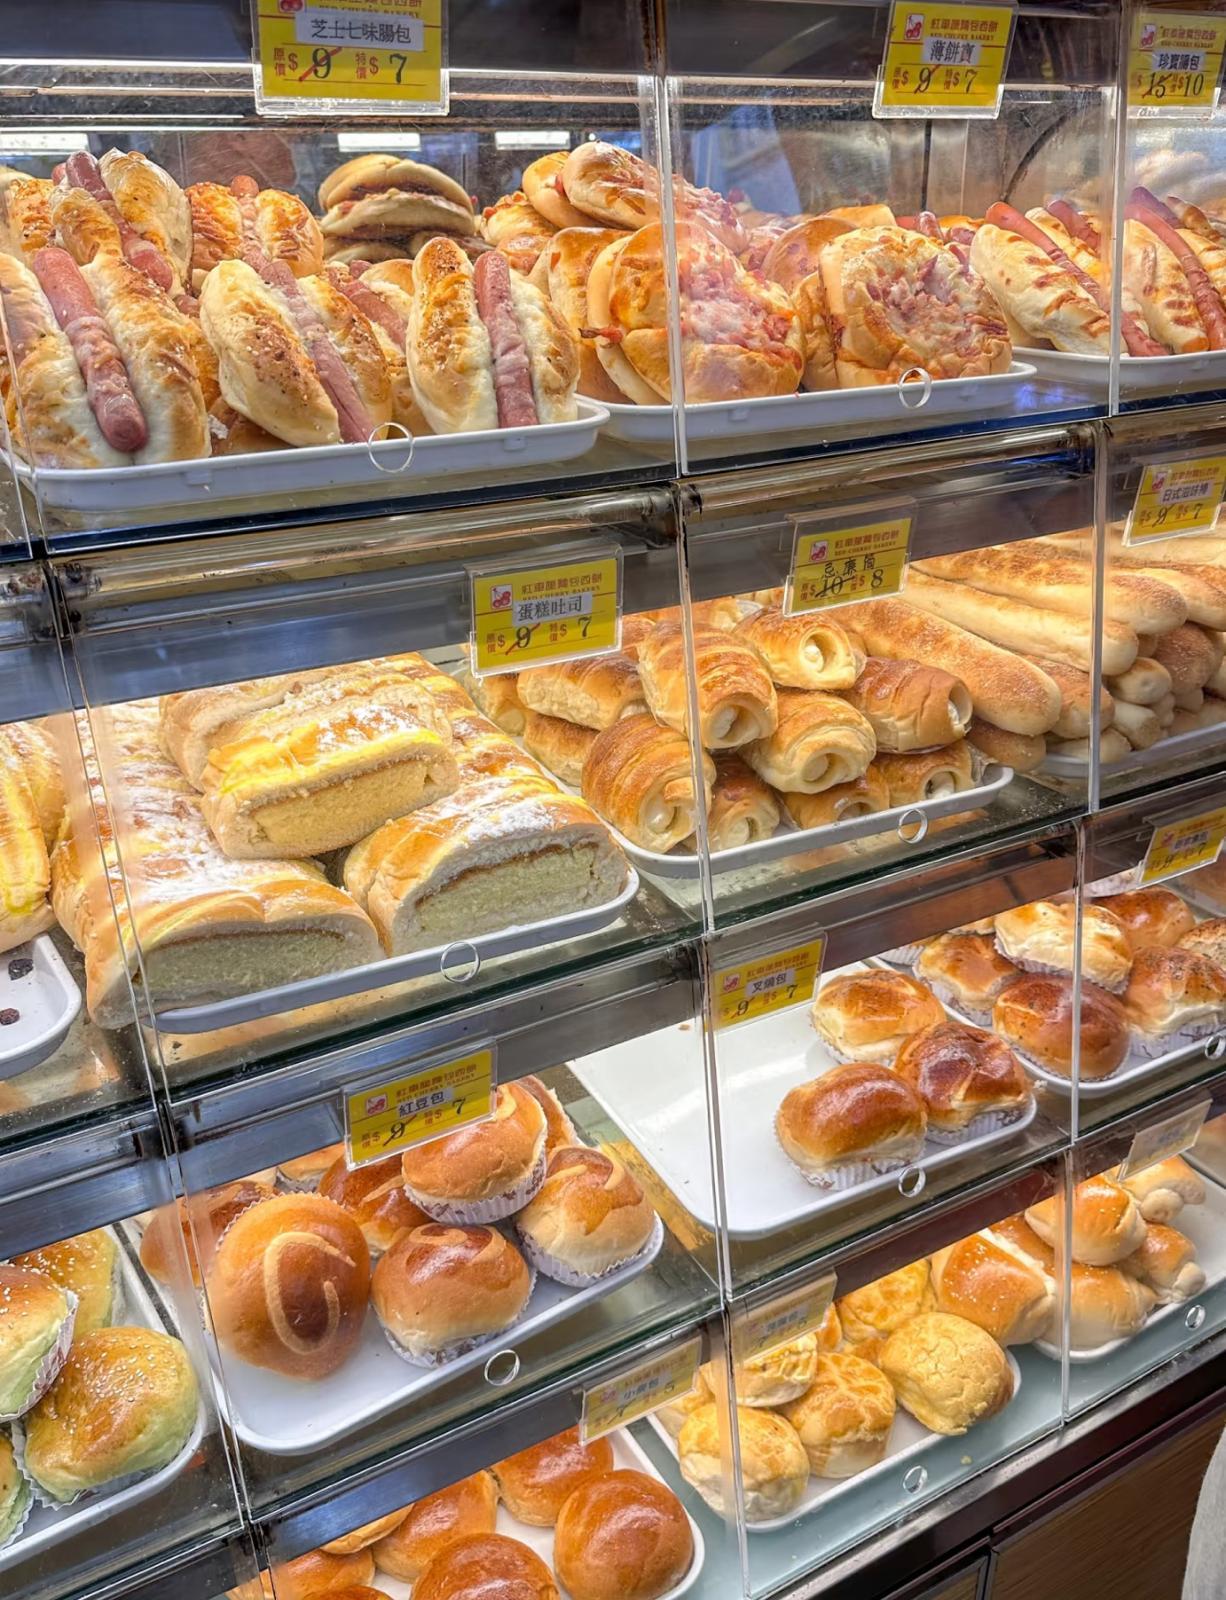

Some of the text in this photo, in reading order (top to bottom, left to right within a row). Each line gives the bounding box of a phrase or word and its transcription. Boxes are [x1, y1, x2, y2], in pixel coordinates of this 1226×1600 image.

[311, 19, 412, 44] 芝士七味腸包
[312, 48, 331, 79] 9
[389, 53, 407, 84] 7
[965, 69, 977, 93] 7
[1184, 73, 1204, 97] 10
[1194, 503, 1203, 519] 7
[871, 569, 883, 588] 8
[518, 595, 582, 621] 蛋糕吐司
[516, 626, 531, 648] 9
[578, 616, 592, 637] 7
[752, 973, 786, 993] 叉燒包
[787, 984, 798, 999] 7
[399, 1091, 444, 1117] 紅豆包
[452, 1098, 466, 1115] 7
